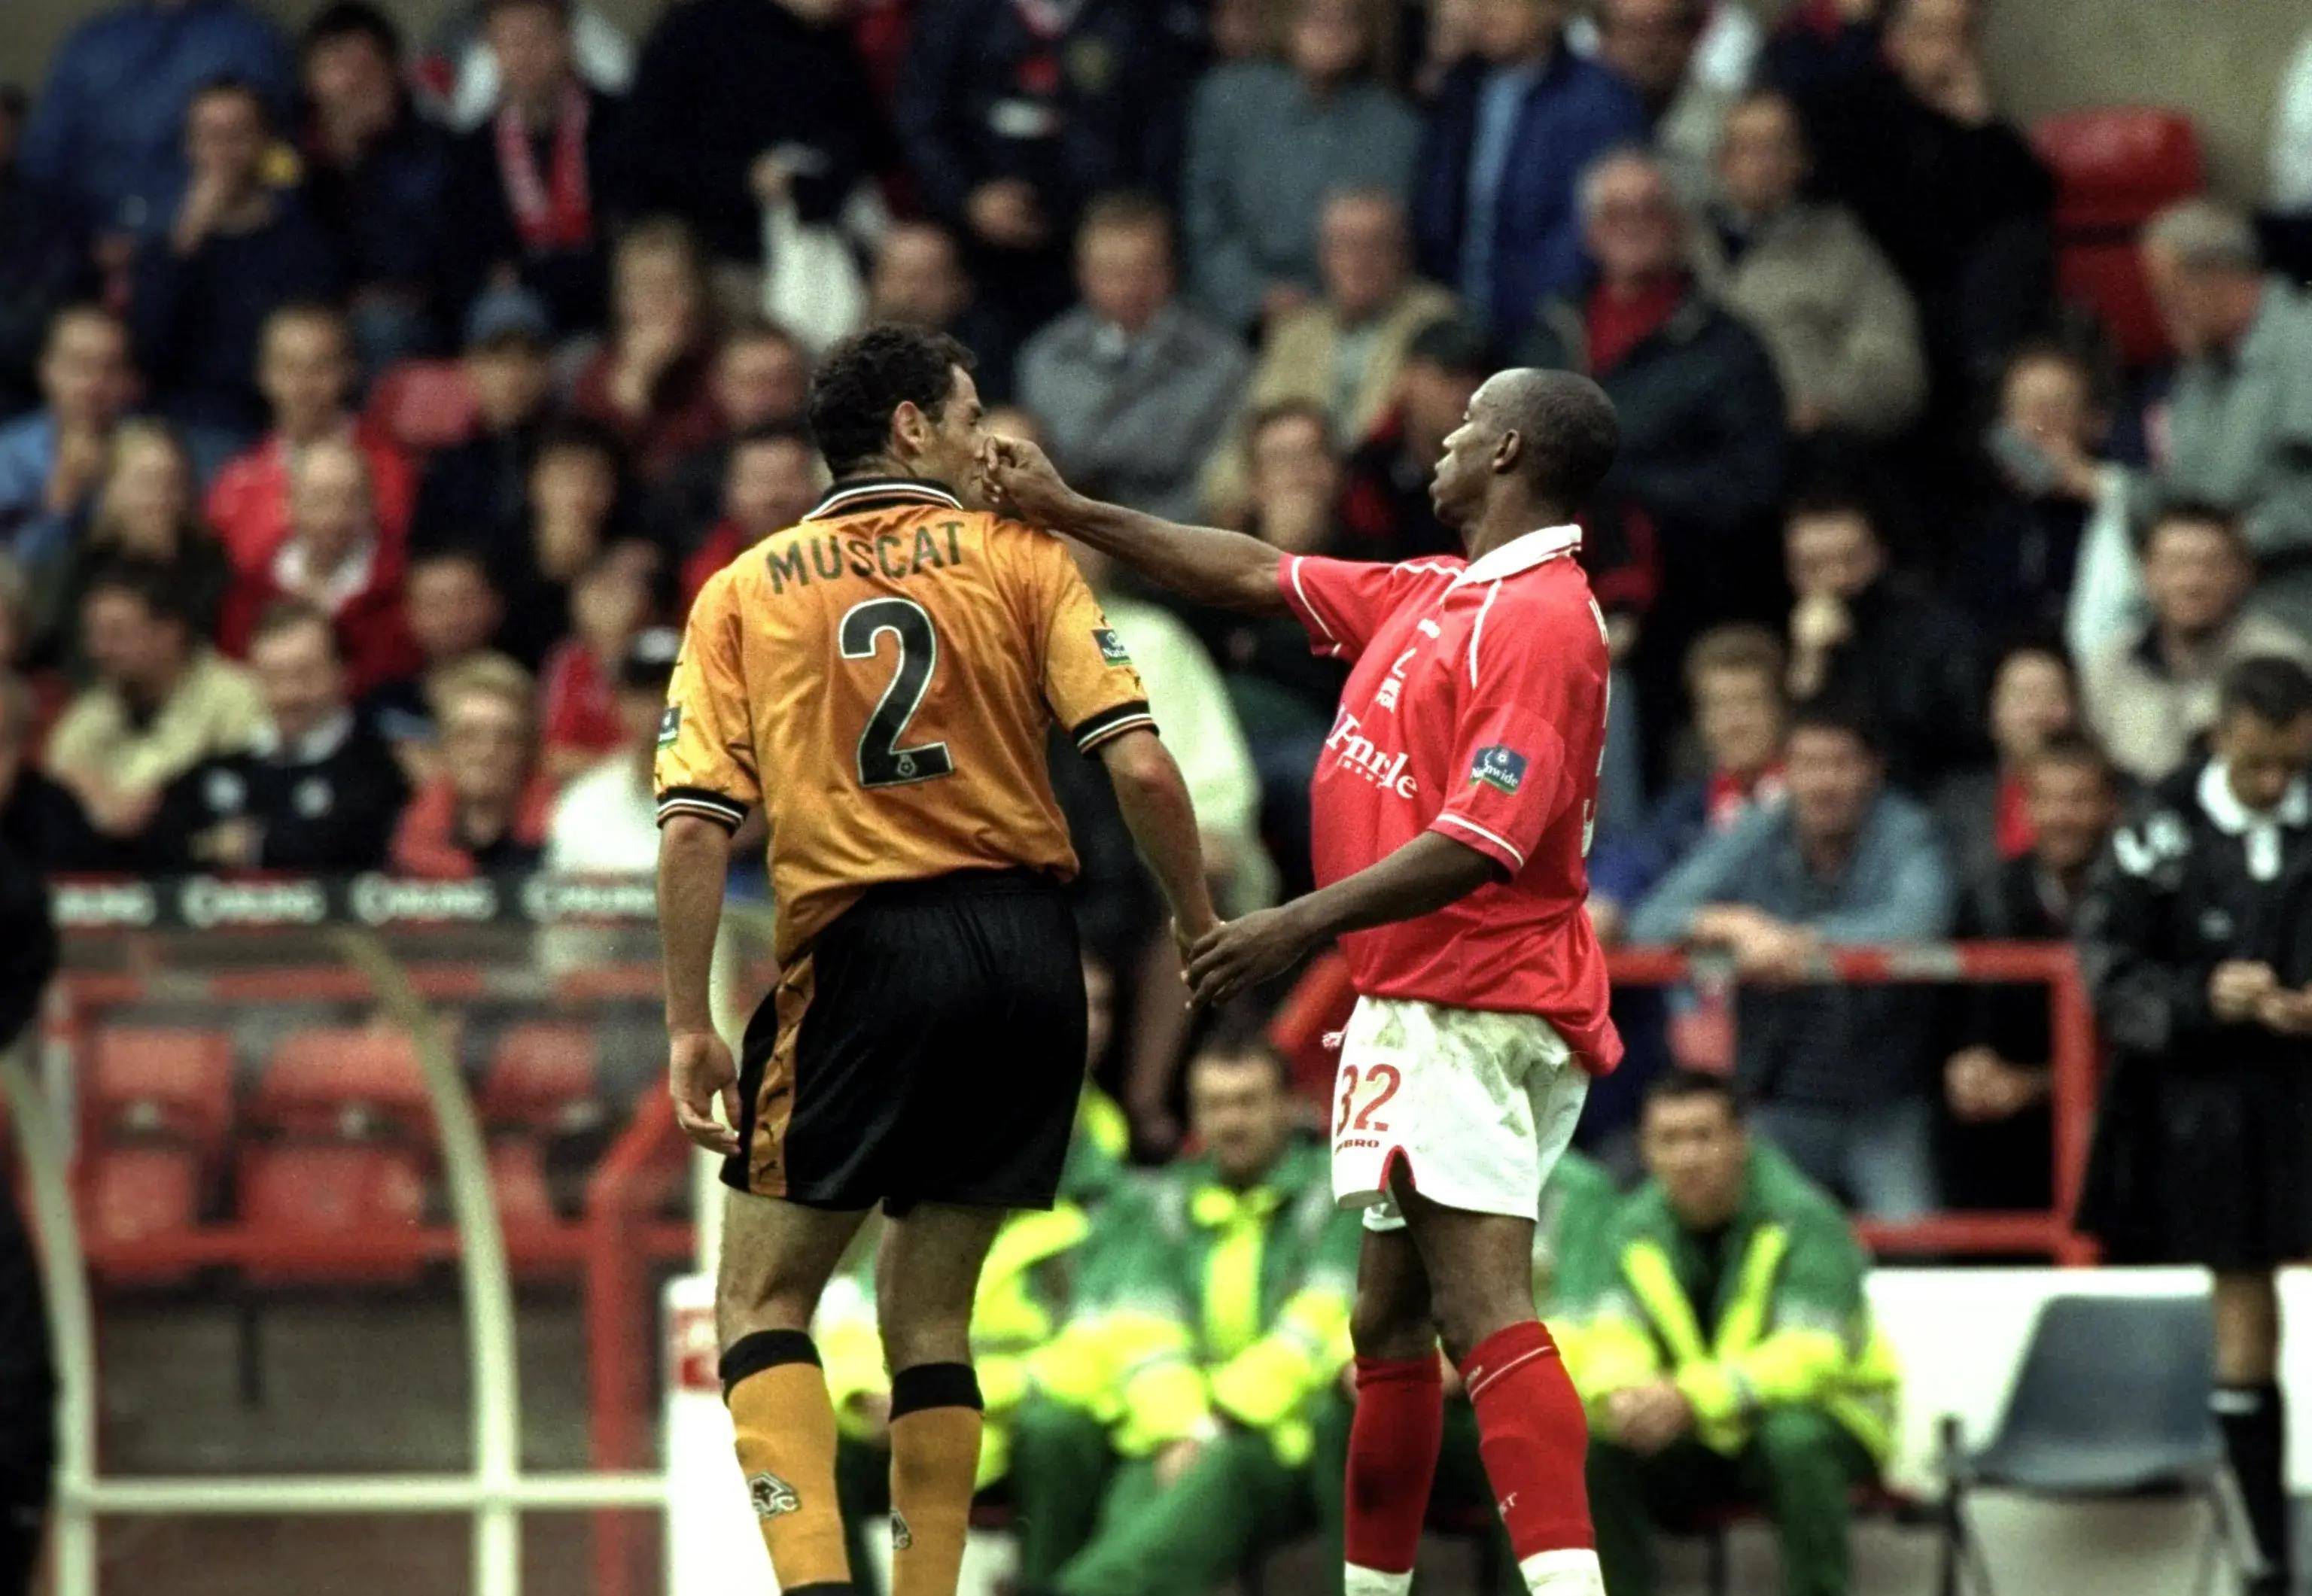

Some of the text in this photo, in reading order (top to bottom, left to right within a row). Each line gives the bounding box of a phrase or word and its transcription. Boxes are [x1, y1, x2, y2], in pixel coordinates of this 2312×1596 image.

[766, 521, 964, 594] MUSCAT
[838, 597, 954, 788] 2
[1337, 1063, 1401, 1136] 32
